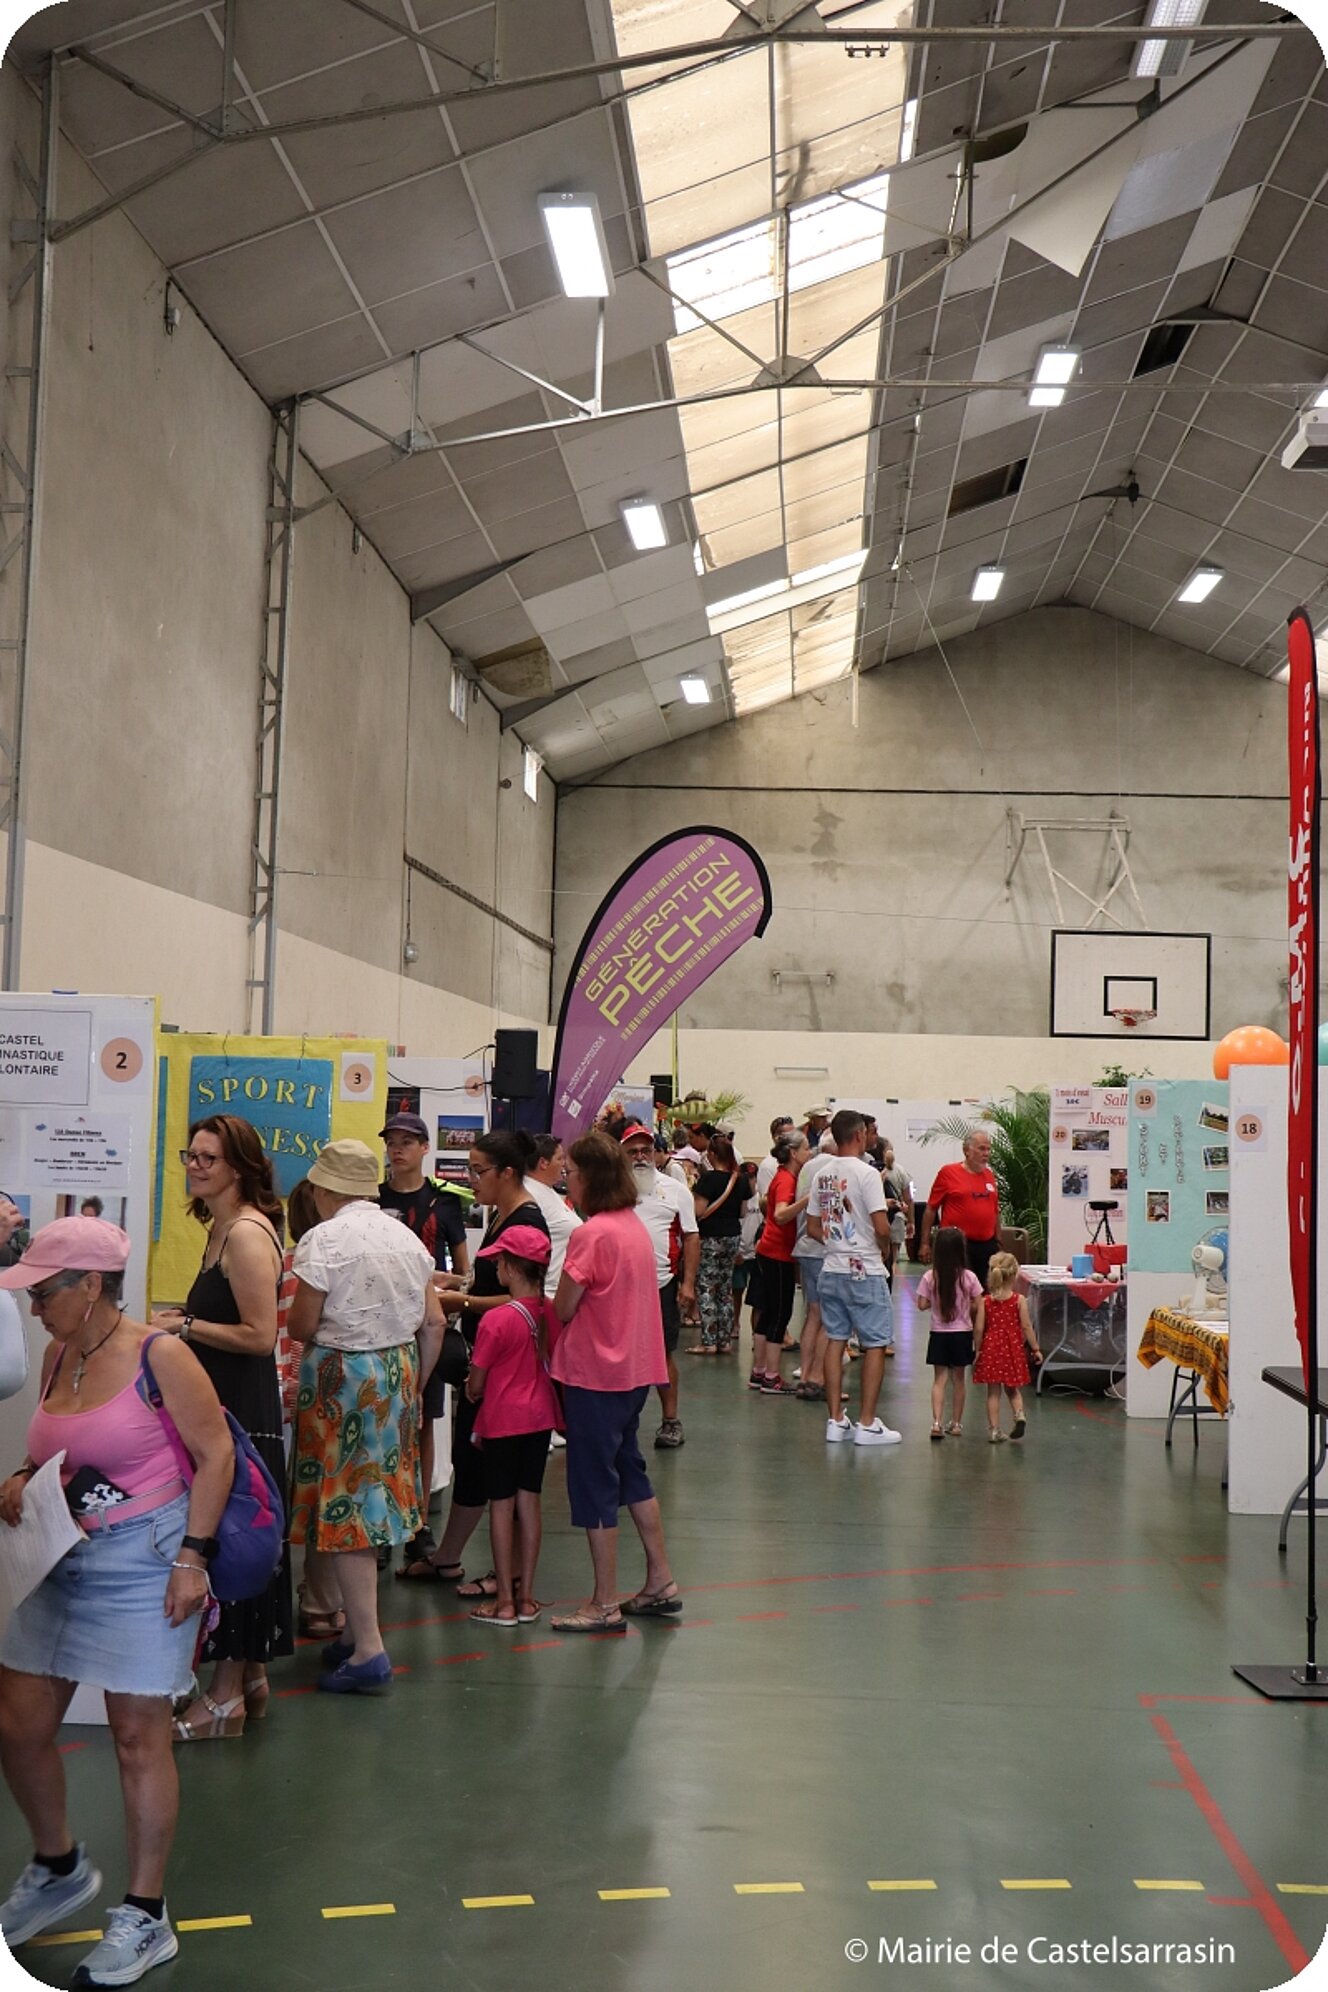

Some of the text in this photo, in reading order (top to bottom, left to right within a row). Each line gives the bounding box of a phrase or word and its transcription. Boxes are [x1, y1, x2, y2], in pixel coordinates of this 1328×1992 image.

[585, 853, 731, 1001] GÉNÉRATION
[598, 870, 754, 1027] PÊCHE
[0, 1034, 44, 1046] CASTEL
[0, 1050, 64, 1061] NASTIQUE
[115, 1052, 127, 1069] 2
[354, 1072, 361, 1085] 3
[197, 1076, 323, 1109] SPORT
[1139, 1095, 1151, 1105] 19
[1088, 1111, 1127, 1126] Muscu
[1241, 1123, 1257, 1135] 18
